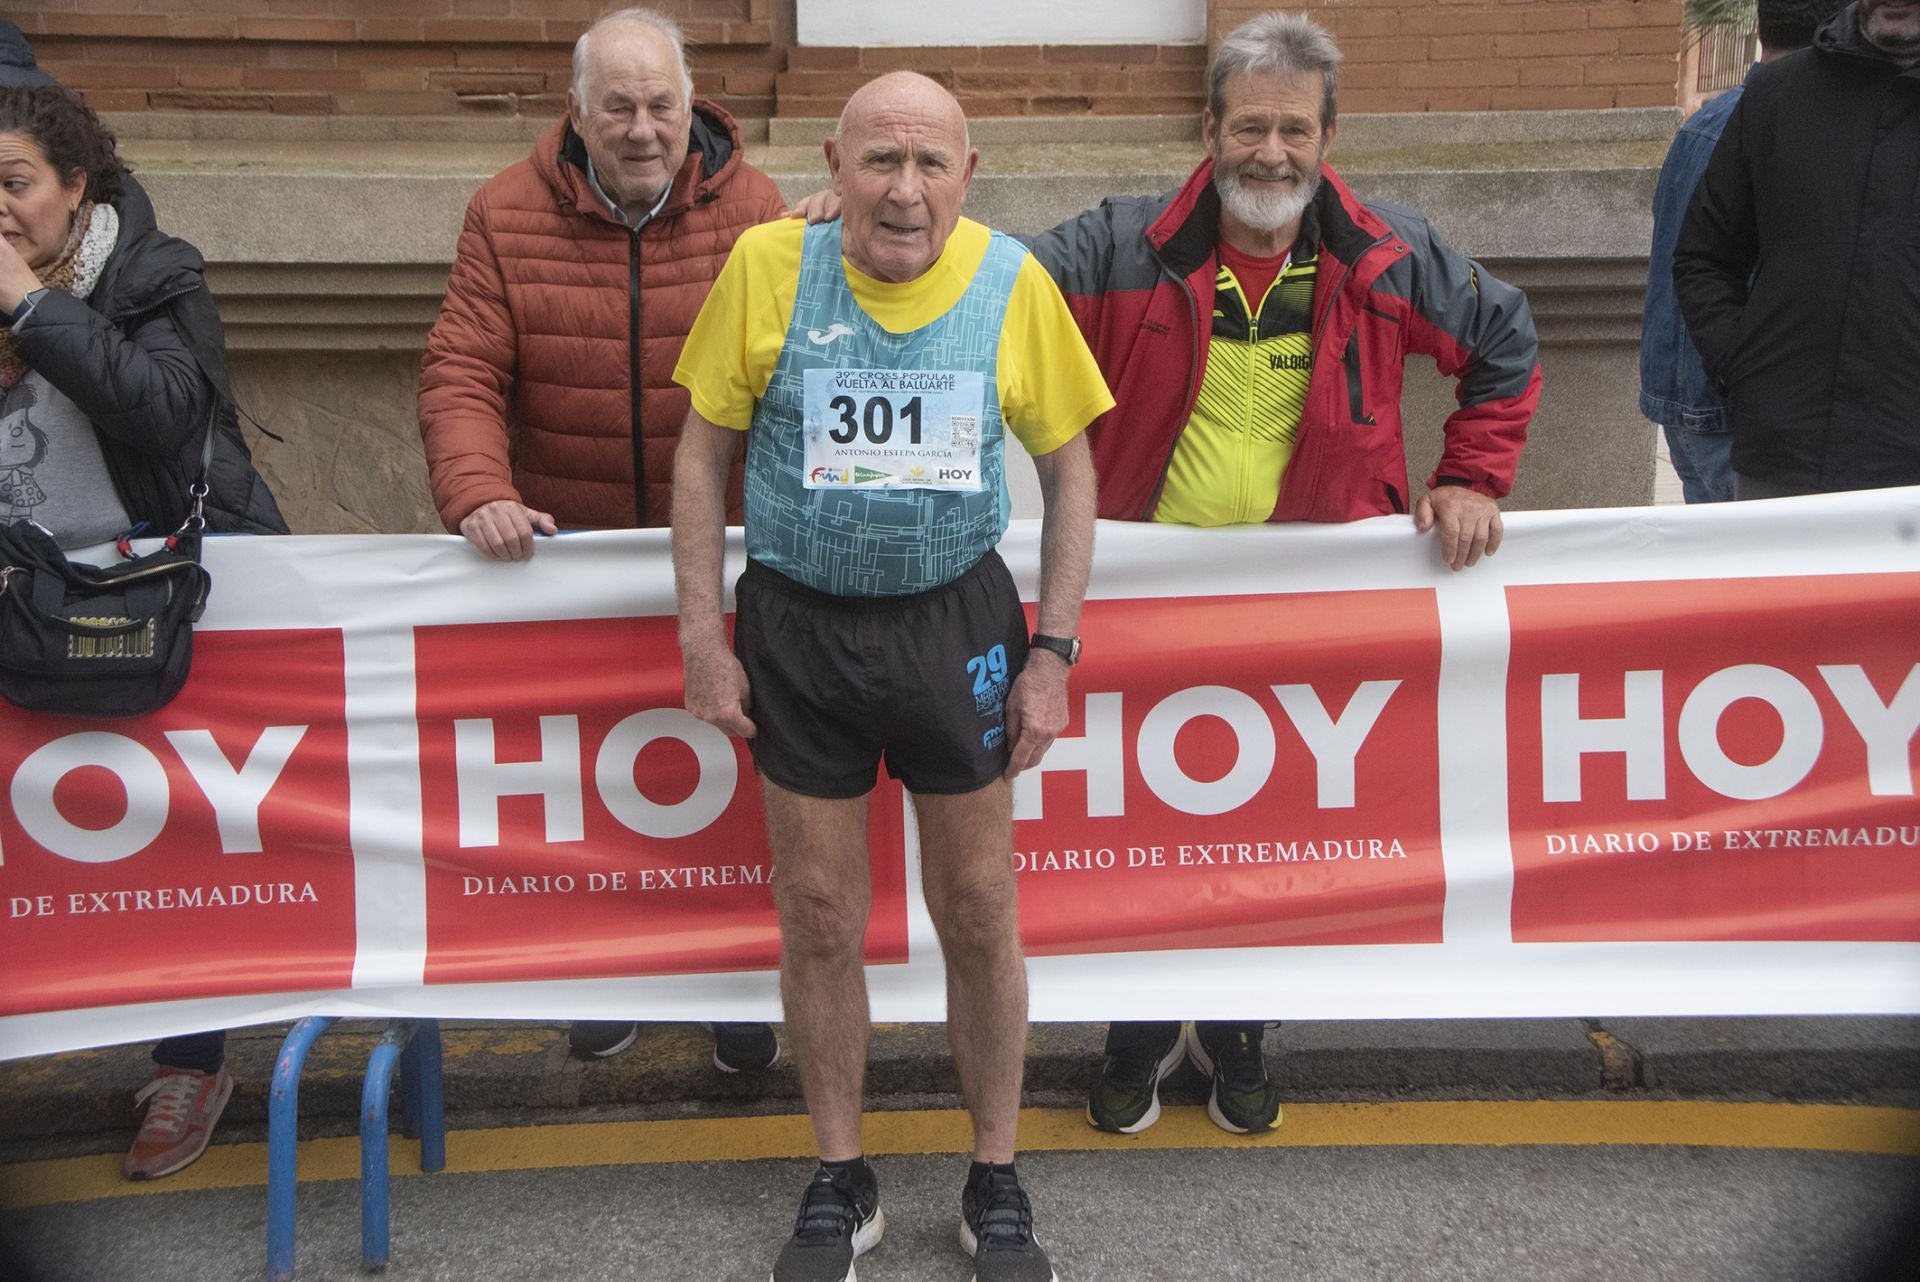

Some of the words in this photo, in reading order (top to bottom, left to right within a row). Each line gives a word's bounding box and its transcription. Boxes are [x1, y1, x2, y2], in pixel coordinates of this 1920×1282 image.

[859, 371, 898, 380] CROSS
[902, 372, 955, 381] POPULAR
[1269, 353, 1313, 370] VALDIG
[836, 379, 877, 389] VUELTA
[882, 380, 896, 390] AL
[900, 380, 955, 391] BALUARTE
[829, 395, 921, 444] 301
[834, 448, 880, 457] ANTONIO
[884, 449, 916, 457] ESTEPA
[939, 469, 972, 480] HOY
[966, 644, 1008, 696] 29
[1540, 662, 1920, 803] HOY
[1012, 679, 1402, 821] HOY
[454, 705, 738, 849] HO
[0, 724, 308, 866] OY
[1127, 846, 1166, 868] DE
[1177, 838, 1407, 866] EXTREMADURA
[1544, 832, 1659, 856] DIARIO
[1670, 831, 1711, 852] DE
[463, 875, 574, 896] DIARIO
[587, 871, 627, 892] DE
[10, 895, 55, 918] DE
[68, 882, 319, 914] EXTREMADURA
